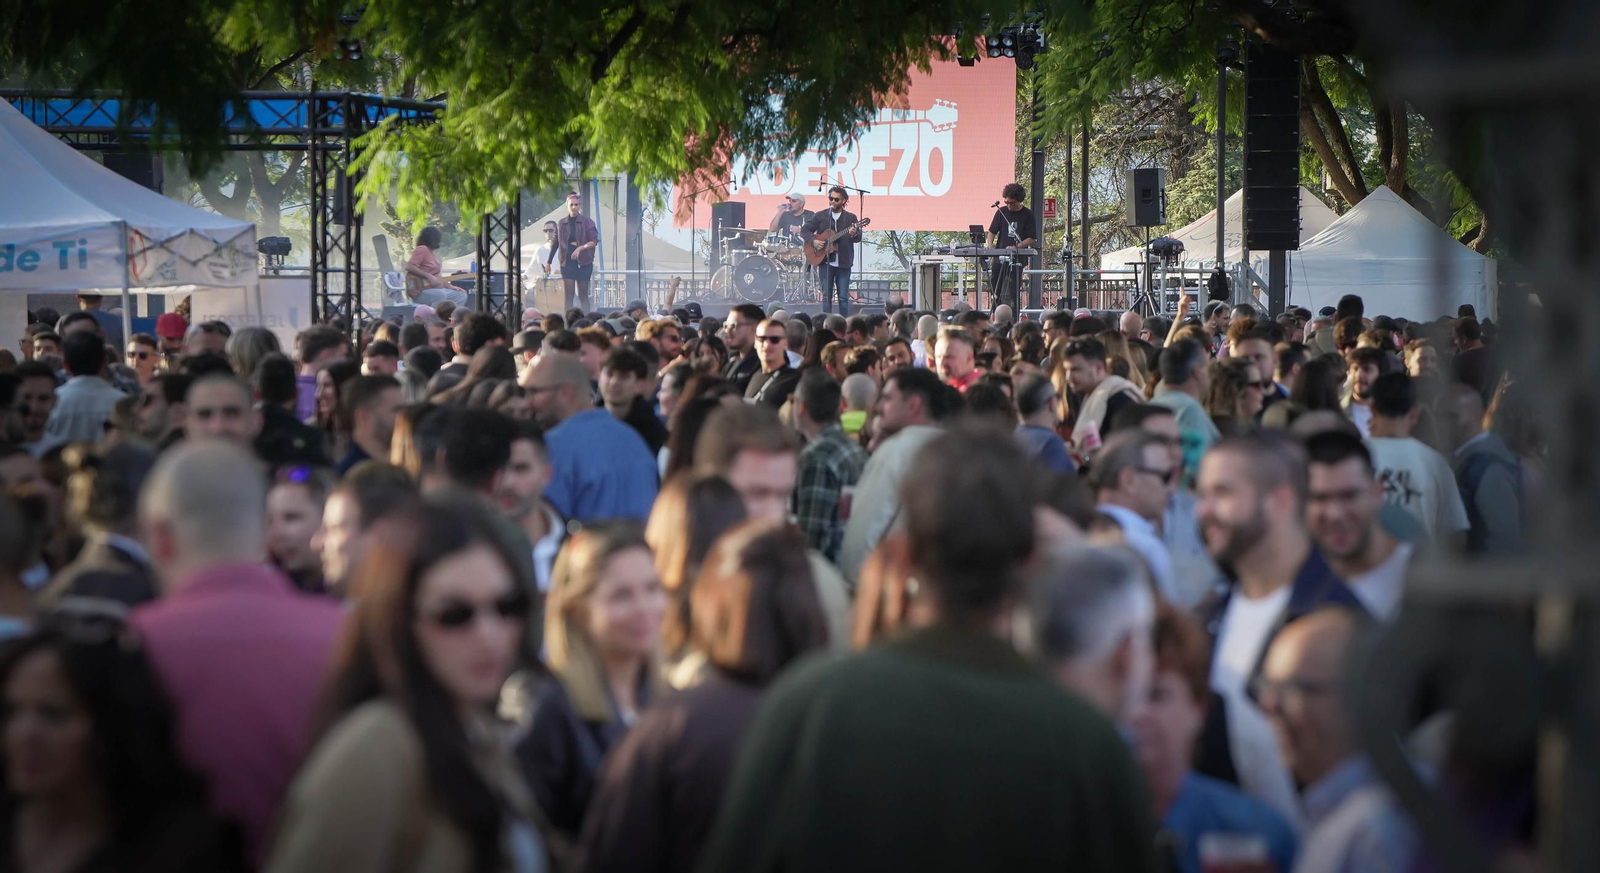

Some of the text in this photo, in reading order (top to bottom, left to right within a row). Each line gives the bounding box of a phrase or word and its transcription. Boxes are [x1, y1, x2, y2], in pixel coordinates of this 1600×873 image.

[729, 122, 954, 197] ADEREZO
[0, 238, 87, 272] de Ti
